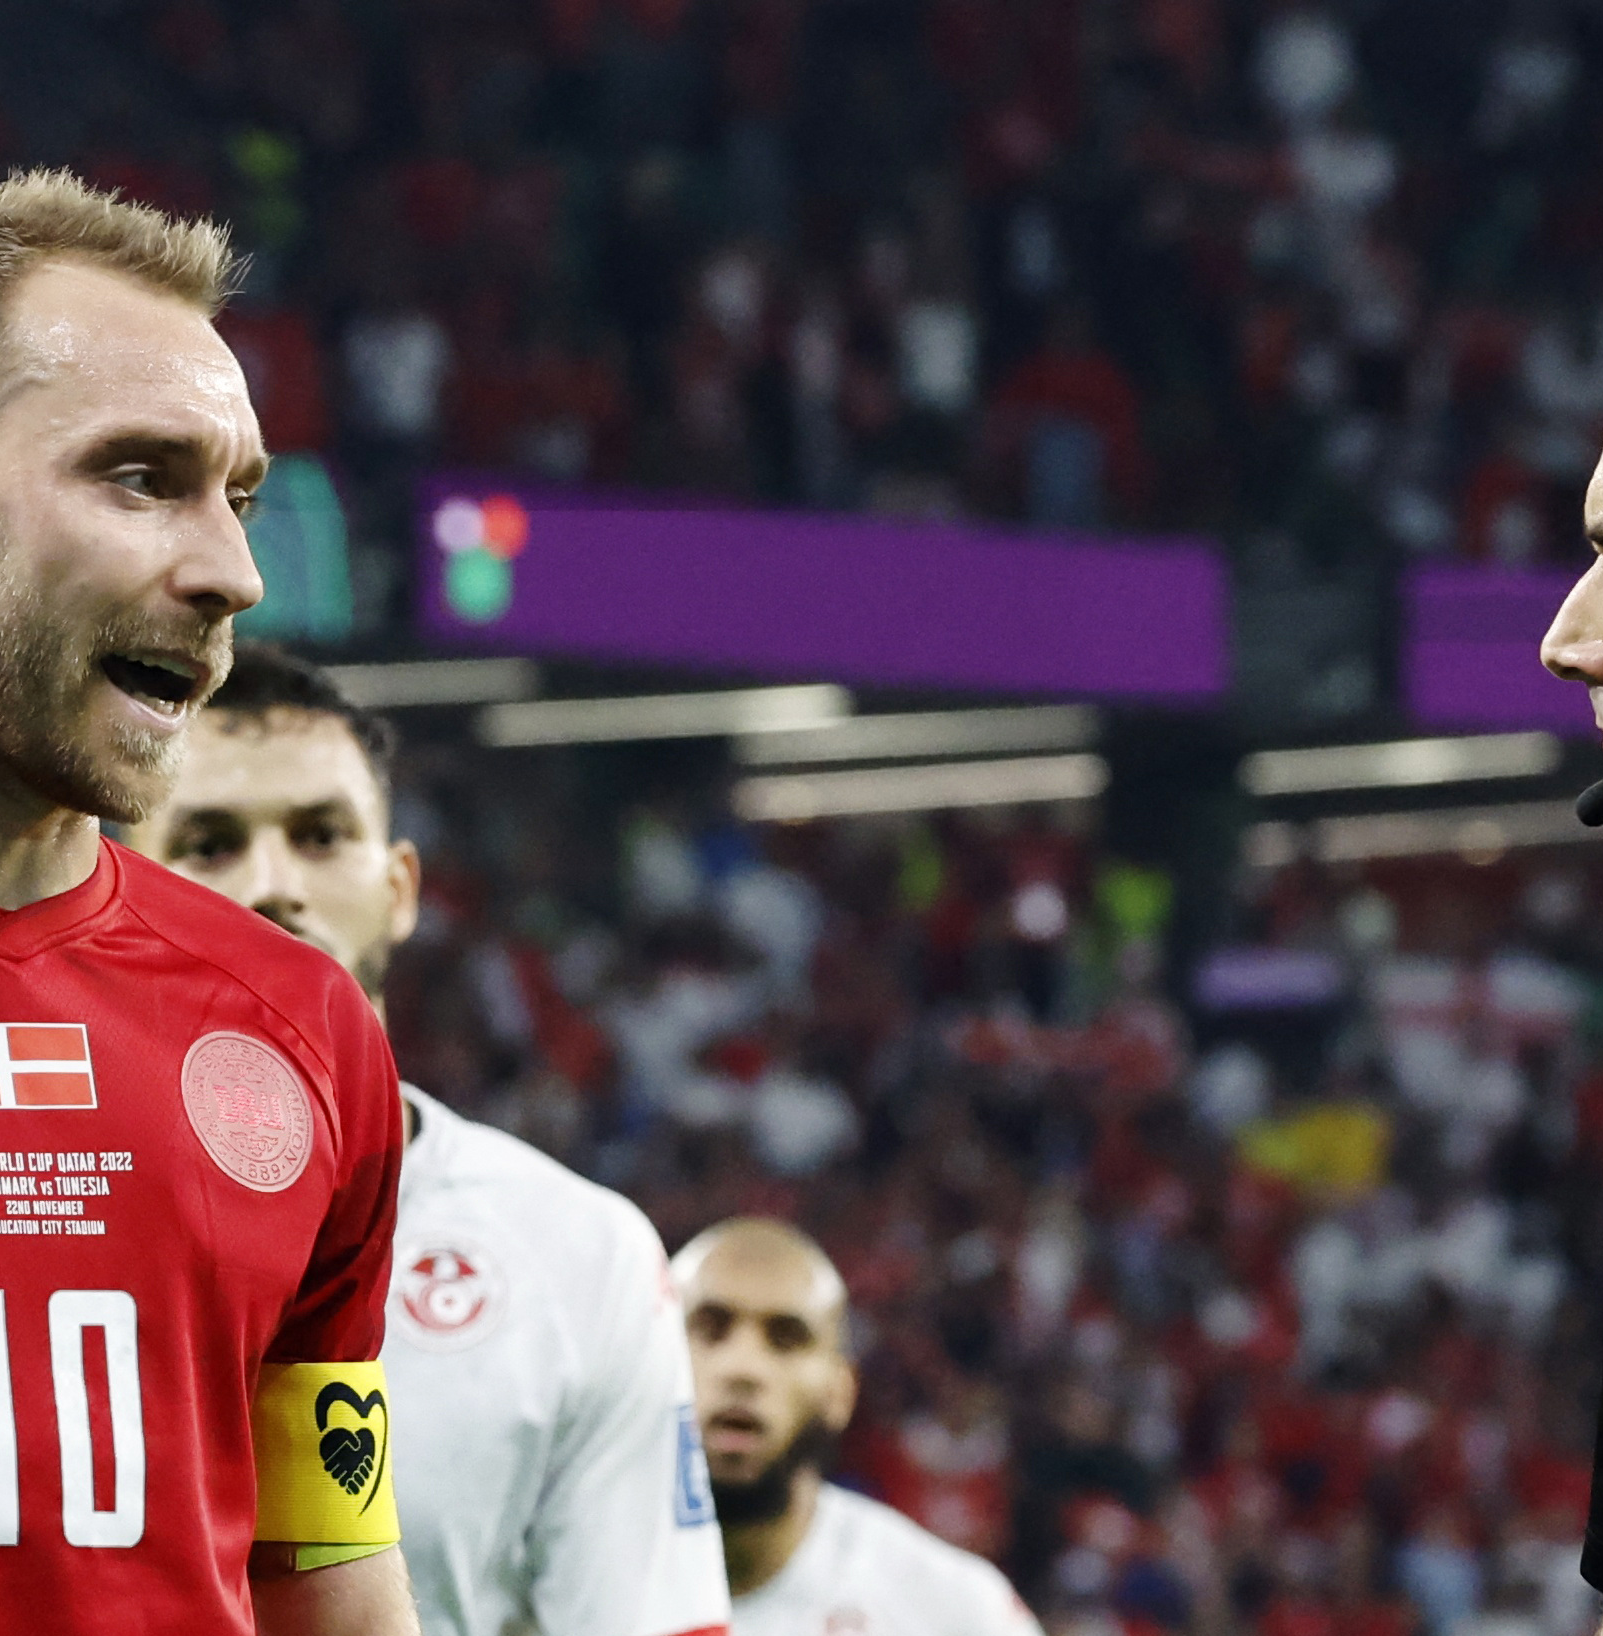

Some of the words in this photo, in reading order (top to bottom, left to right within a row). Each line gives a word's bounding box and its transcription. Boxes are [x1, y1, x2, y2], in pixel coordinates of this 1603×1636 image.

[27, 1152, 53, 1172] CUP
[57, 1152, 96, 1173] QATAR
[99, 1152, 133, 1171] 2022
[54, 1176, 110, 1196] TUNESIA
[6, 1200, 31, 1215] 22ND
[33, 1200, 84, 1216] NOVEMBER
[41, 1220, 62, 1235] CITY
[65, 1220, 106, 1236] STADIUM
